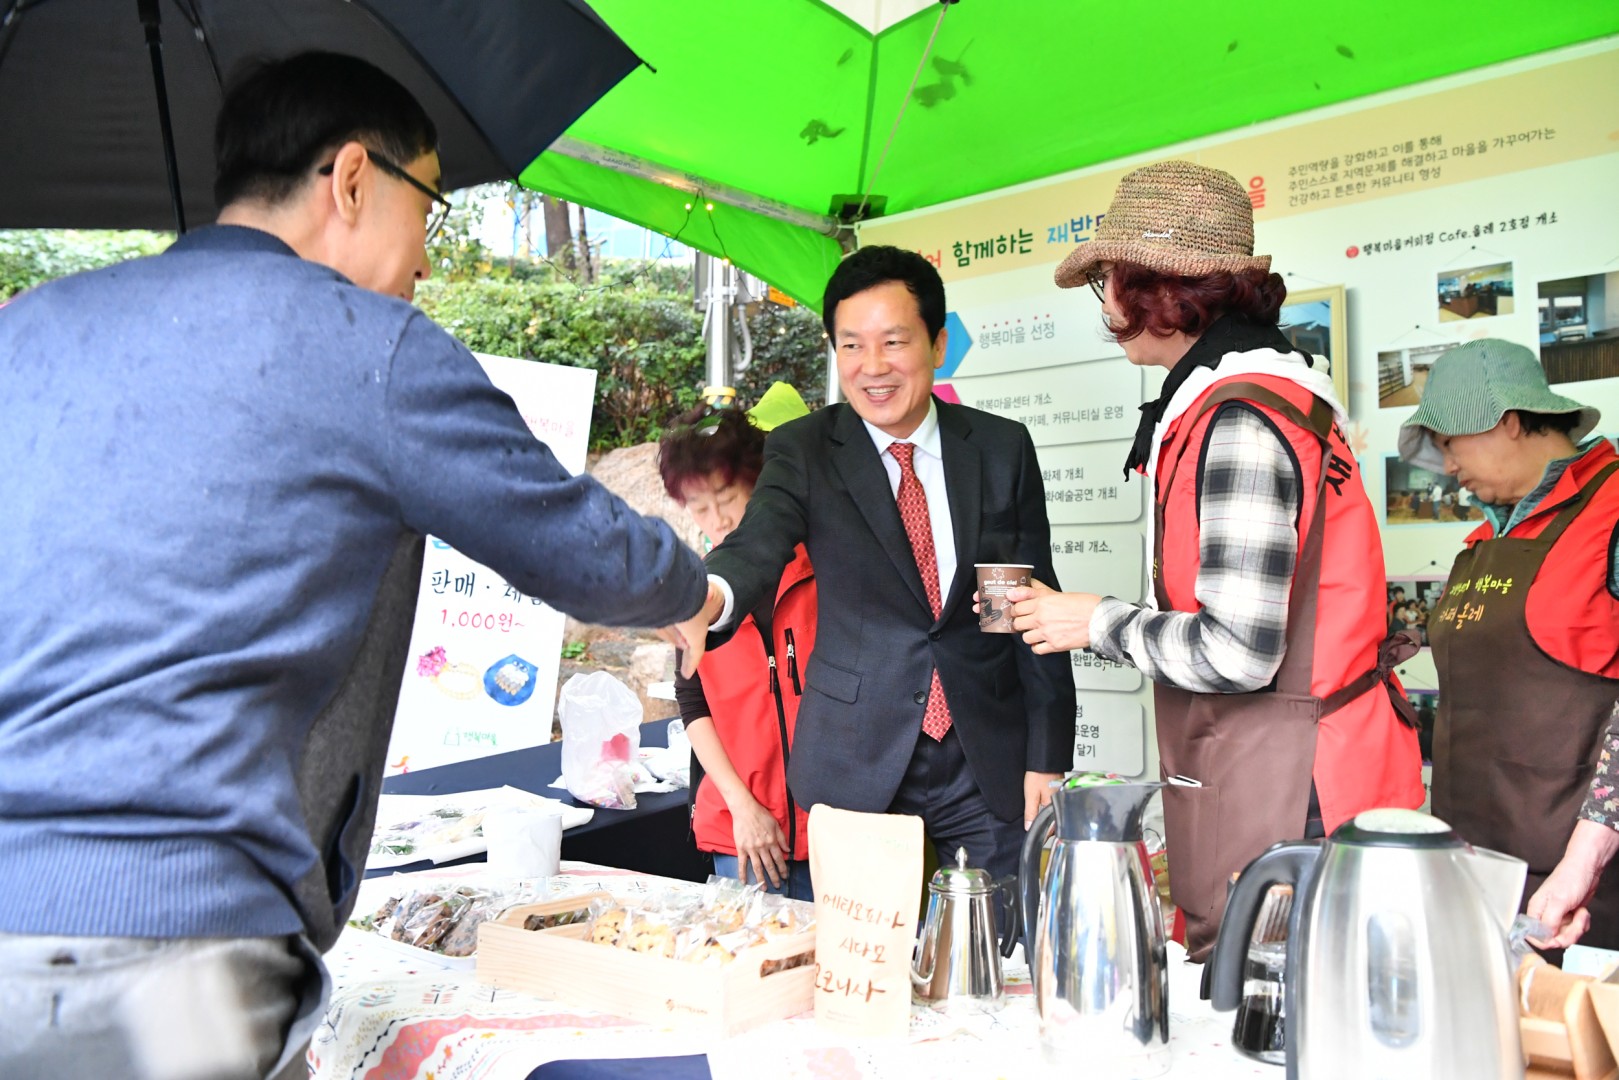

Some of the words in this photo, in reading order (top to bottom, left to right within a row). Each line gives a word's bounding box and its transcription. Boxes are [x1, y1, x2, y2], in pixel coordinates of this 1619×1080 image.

[1288, 157, 1340, 177] 주민역량을
[1344, 146, 1389, 166] 강화하고
[1392, 140, 1414, 154] 이를
[1419, 135, 1442, 150] 통해
[1288, 172, 1338, 191] 주민스스로
[1343, 159, 1397, 179] 지역문제를
[1401, 149, 1448, 167] 해결하고
[1452, 140, 1488, 156] 마을을
[1493, 127, 1556, 149] 가꾸어가는
[1288, 188, 1331, 207] 건강하고
[1334, 182, 1366, 198] 튼튼한
[1370, 172, 1415, 189] 커뮤니티
[1418, 166, 1441, 181] 형성
[952, 228, 1034, 268] 함께하는
[1047, 213, 1106, 244] 재반
[1363, 232, 1434, 256] 행복마을커피점
[1499, 215, 1530, 232] 2호점
[1535, 211, 1558, 226] 개소
[979, 326, 1025, 349] 행복마을
[1031, 321, 1055, 341] 선정
[976, 394, 1030, 411] 행복마을센터
[1033, 393, 1053, 406] 개소
[1052, 408, 1099, 425] 커뮤니티실
[1103, 405, 1124, 420] 운영
[1065, 467, 1084, 481] 개최
[1097, 486, 1117, 500] 개최
[432, 569, 475, 598] 판매
[823, 894, 905, 929] 에티오피아
[839, 937, 886, 963] 시다모
